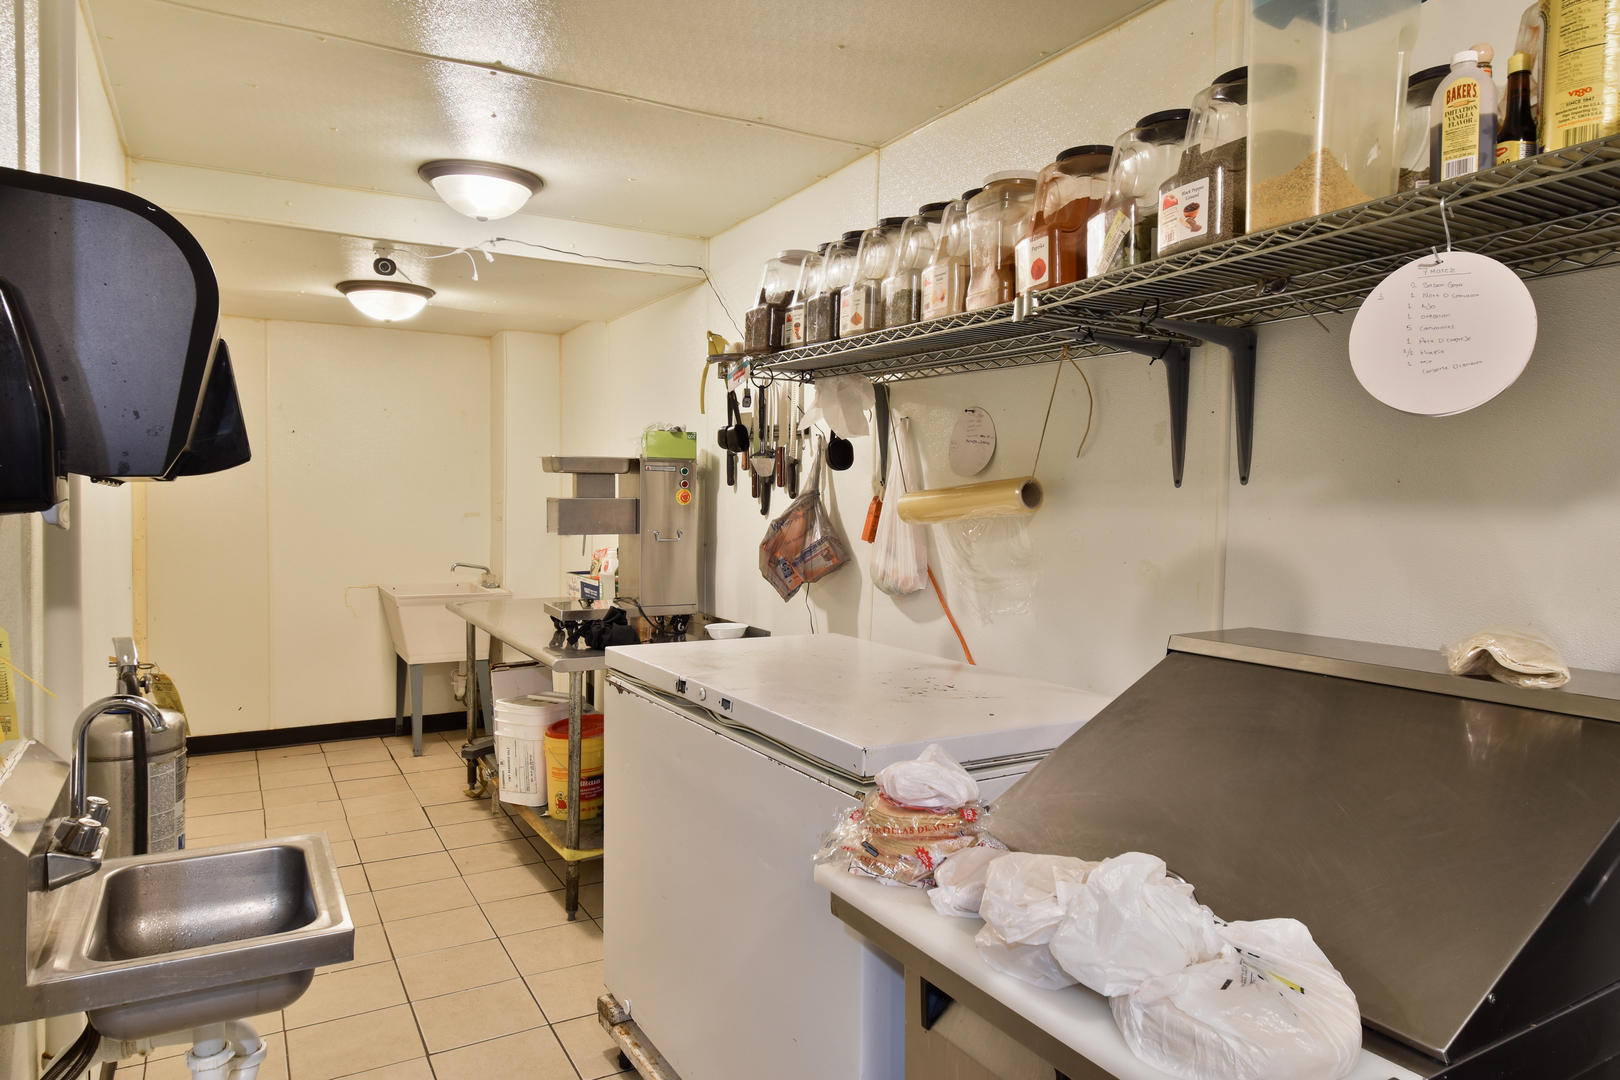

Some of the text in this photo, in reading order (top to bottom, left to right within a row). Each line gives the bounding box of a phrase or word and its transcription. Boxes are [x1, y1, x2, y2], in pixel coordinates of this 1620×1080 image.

[1446, 82, 1477, 106] BAKER'S
[1444, 104, 1478, 118] IMITATION
[1448, 111, 1474, 122] VANILLA
[1448, 118, 1473, 128] FLAVOR
[918, 826, 931, 834] DE
